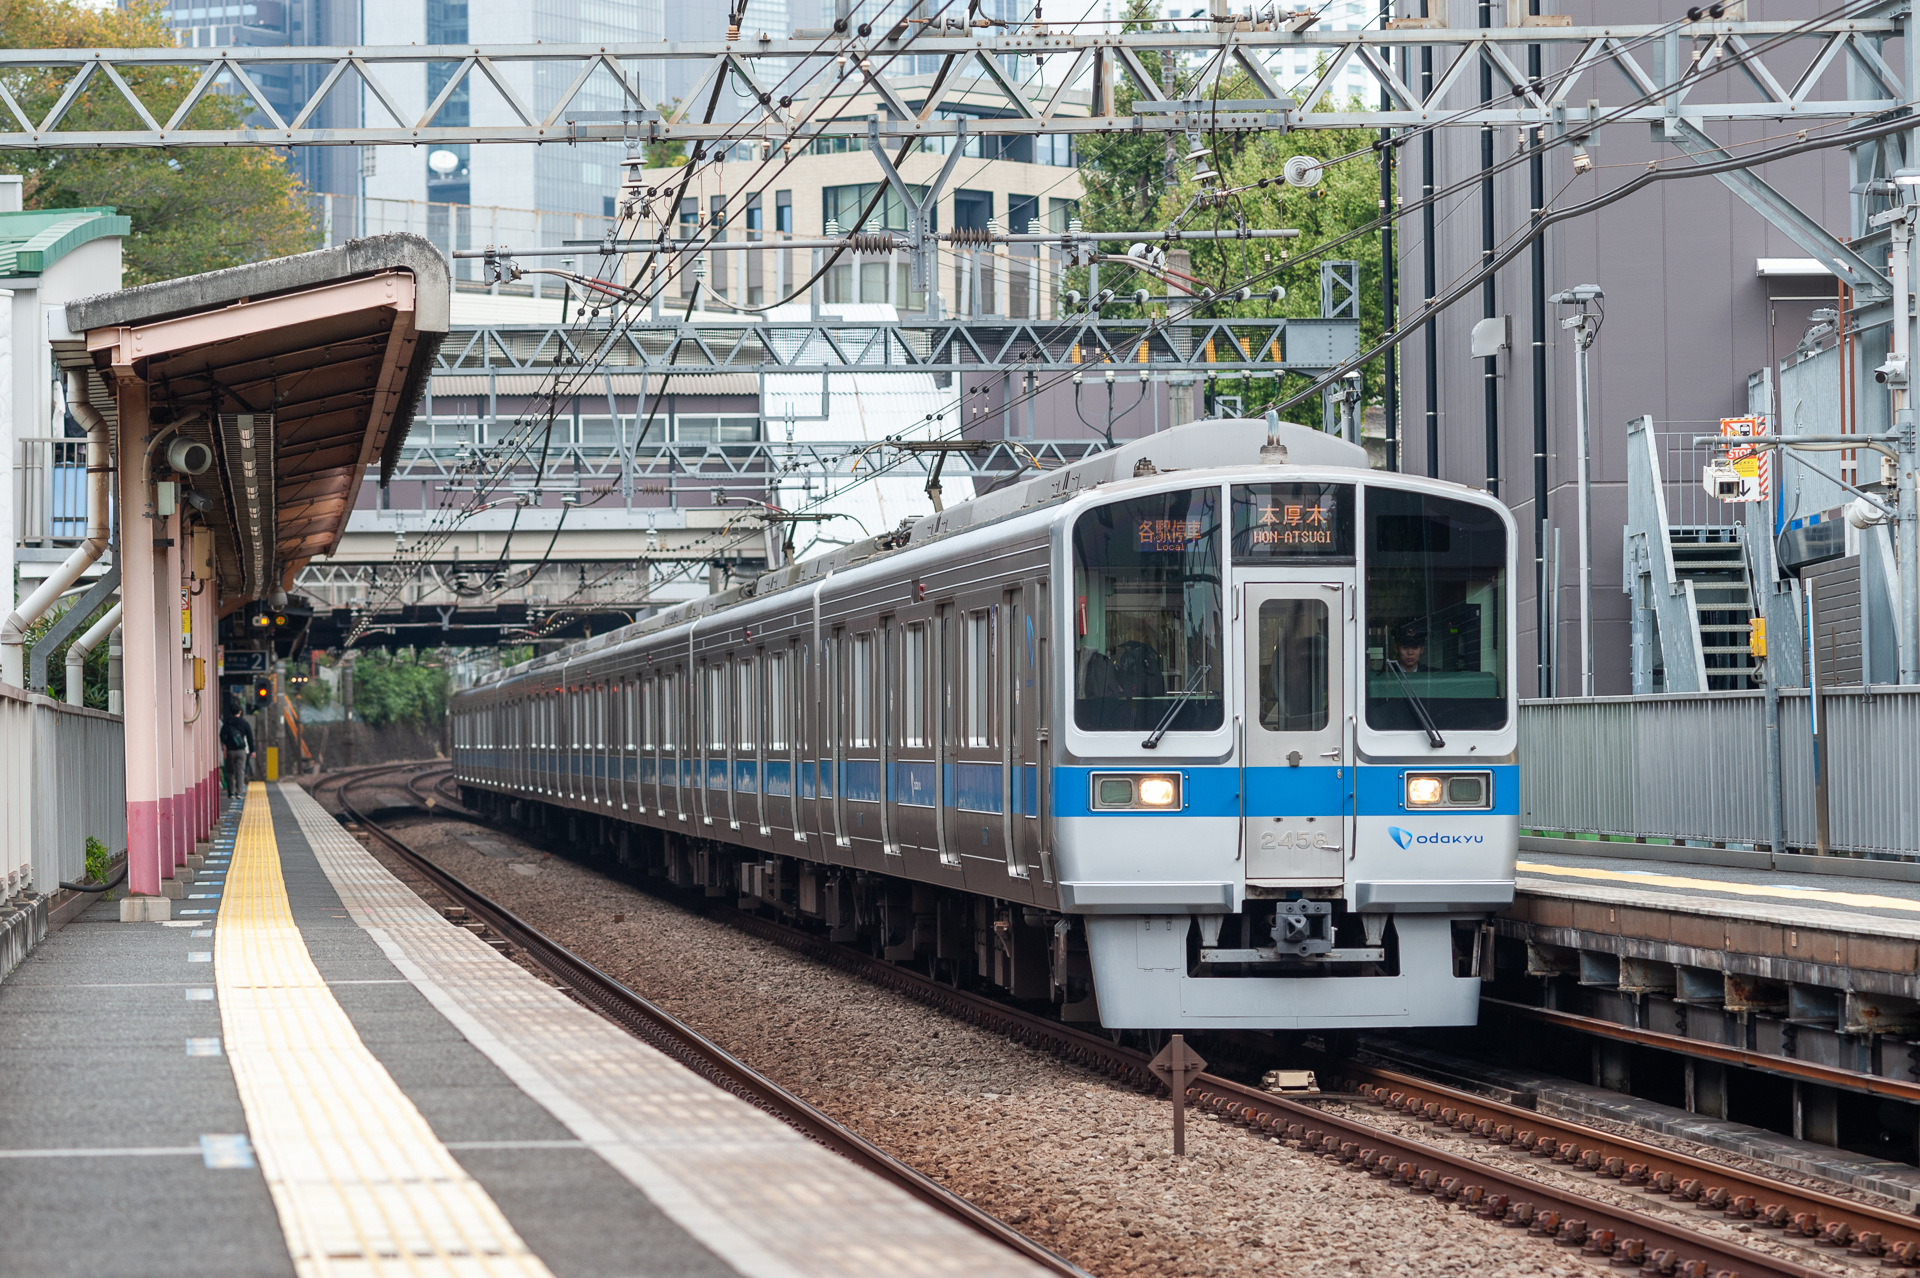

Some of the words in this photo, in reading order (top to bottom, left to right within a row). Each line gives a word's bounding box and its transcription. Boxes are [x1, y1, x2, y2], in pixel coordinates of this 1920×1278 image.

[1258, 504, 1327, 526] 本厚木
[1139, 520, 1202, 543] 各駅停車
[1253, 530, 1331, 543] HON-ATSUGI
[1156, 543, 1185, 551] Local
[251, 653, 263, 670] 2
[1261, 831, 1329, 850] 2458
[1416, 832, 1484, 844] odakyu
